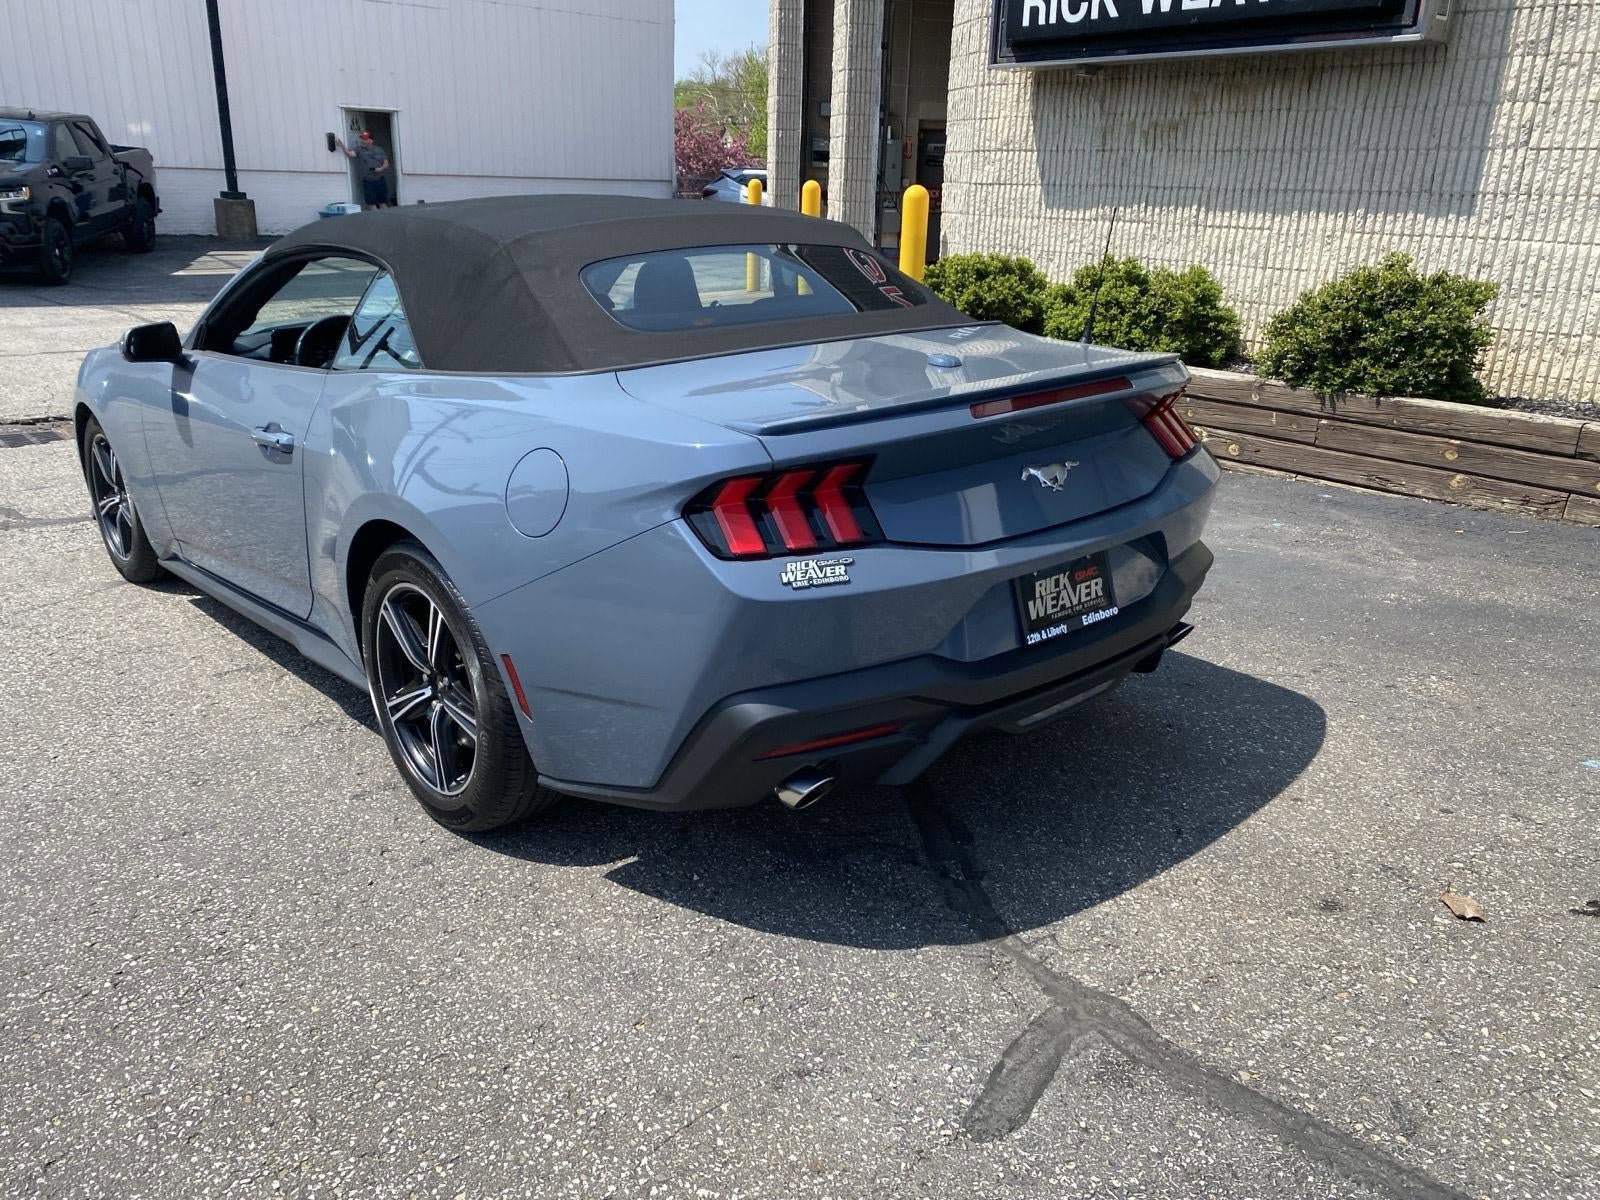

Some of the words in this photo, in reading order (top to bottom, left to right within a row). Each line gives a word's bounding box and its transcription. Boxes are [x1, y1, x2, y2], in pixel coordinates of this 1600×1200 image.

[781, 565, 846, 583] WEAVER
[786, 560, 817, 572] RICK
[792, 580, 809, 588] ERIE
[813, 575, 849, 585] EDINBORO
[1035, 571, 1070, 598] RICK
[1075, 567, 1099, 580] GMC
[1028, 577, 1104, 621] WEAVER
[1082, 607, 1119, 626] Edinboro
[1027, 632, 1041, 645] 12th
[1041, 629, 1047, 639] &
[1047, 624, 1067, 638] Liberty
